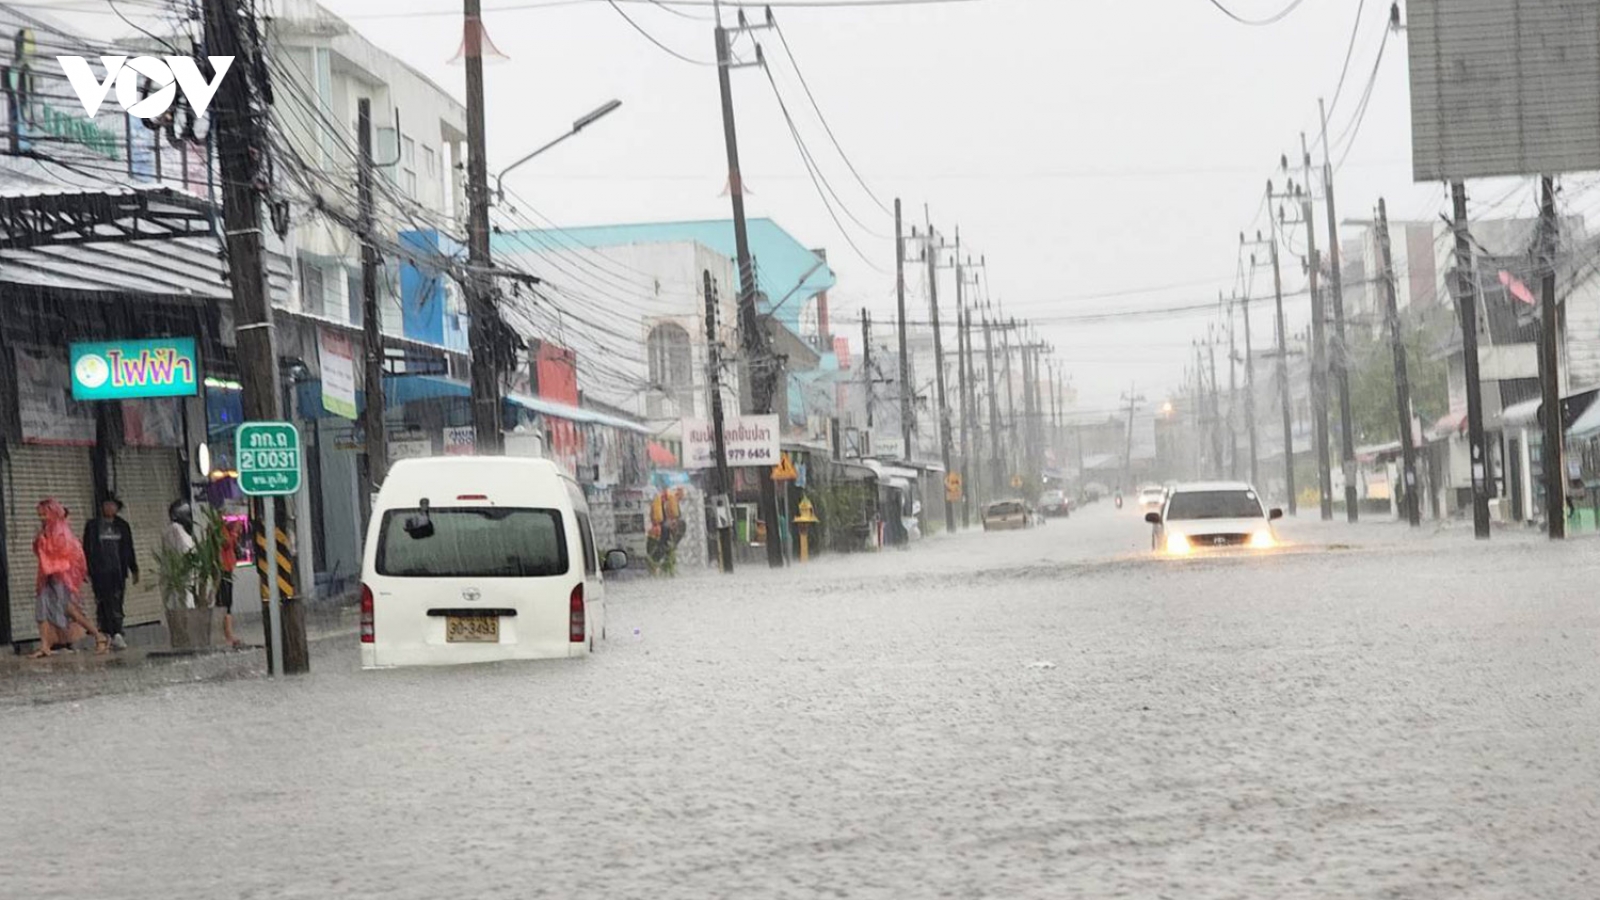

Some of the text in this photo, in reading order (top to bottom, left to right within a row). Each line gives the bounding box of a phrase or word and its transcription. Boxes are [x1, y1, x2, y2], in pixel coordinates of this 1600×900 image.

[107, 347, 193, 387] ไฟฟ้า
[241, 451, 295, 469] 2 0031
